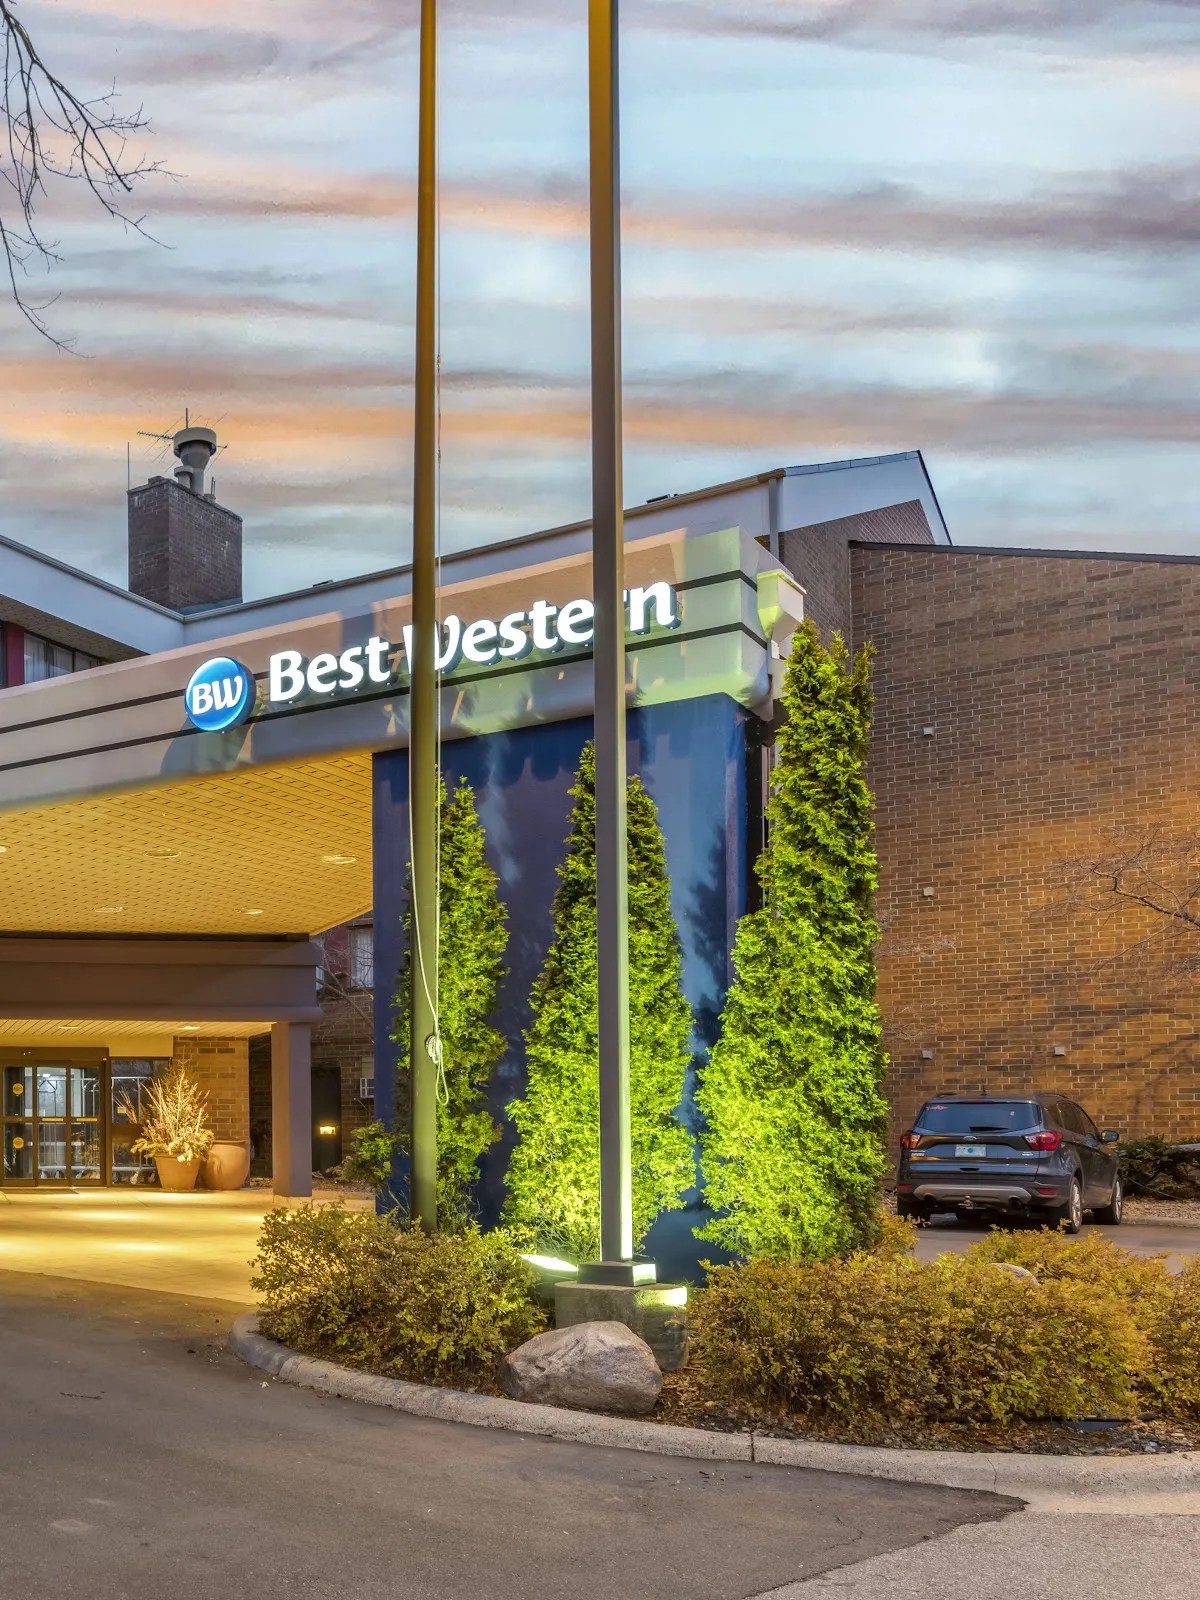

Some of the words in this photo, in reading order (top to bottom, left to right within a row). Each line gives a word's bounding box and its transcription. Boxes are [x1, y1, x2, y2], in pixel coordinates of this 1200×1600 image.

[192, 675, 243, 715] BW
[270, 636, 391, 702] Best
[403, 581, 676, 676] Westen
